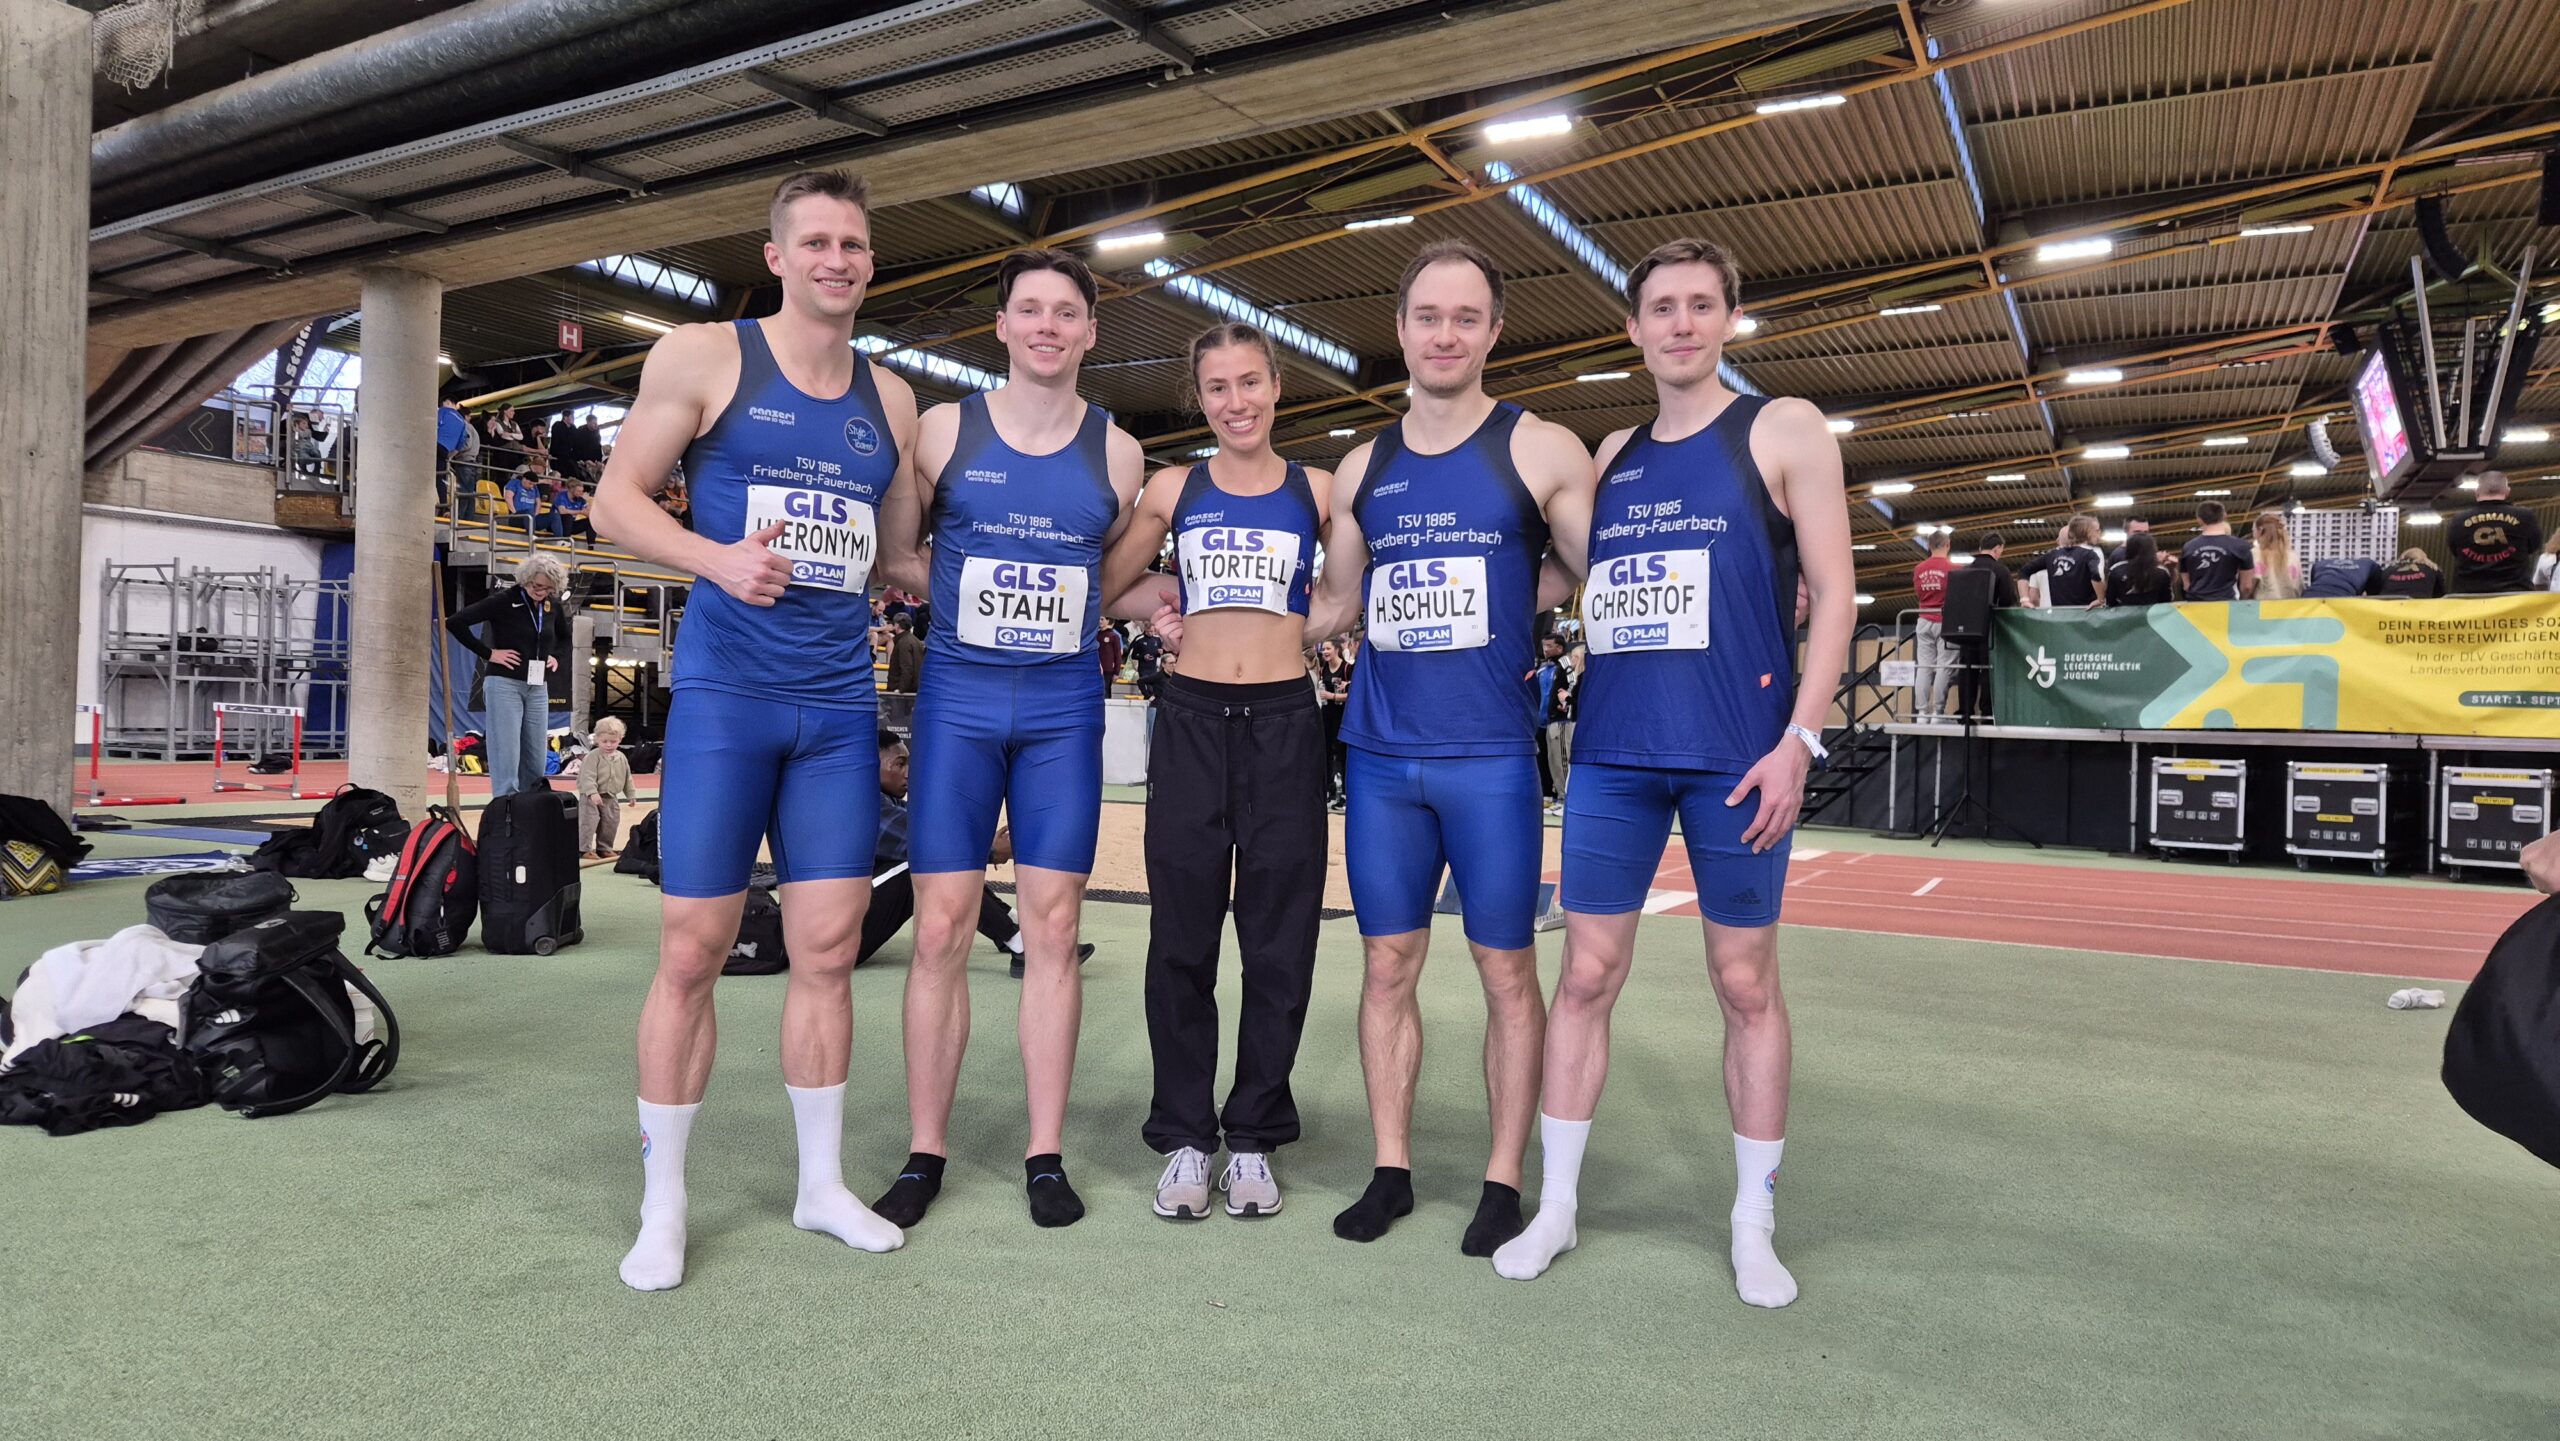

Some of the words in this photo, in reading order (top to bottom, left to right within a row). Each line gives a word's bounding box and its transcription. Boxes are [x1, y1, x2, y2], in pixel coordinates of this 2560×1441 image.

[563, 325, 577, 347] H
[286, 322, 313, 378] Stölti
[749, 405, 795, 421] panzeri
[796, 456, 816, 472] TSV
[818, 460, 842, 476] 1885
[752, 464, 874, 496] Friedberg-Fauerbach
[965, 469, 1007, 480] panzeri
[1373, 478, 1409, 496] panzeri
[1185, 509, 1225, 525] panzeri
[1627, 503, 1652, 520] TSV
[1654, 499, 1683, 518] 1885
[1008, 512, 1027, 526] TSV
[1029, 515, 1053, 529] 1885
[1397, 513, 1422, 529] TSV
[1424, 512, 1457, 528] 1885
[1596, 514, 1728, 541] riedberg-Fauerbach
[2464, 512, 2521, 528] GERMANY
[972, 521, 1085, 544] Friedberg-Fauerbach
[814, 565, 844, 580] PLAN
[1229, 588, 1262, 599] PLAN
[978, 589, 1070, 623] STAHL
[1376, 588, 1476, 624] H.SCHULZ
[1591, 585, 1696, 622] CHRISTOF
[2378, 619, 2413, 631] DEIN
[2418, 617, 2530, 631] FREIWILLIGES
[2535, 616, 2560, 629] SO
[1019, 631, 1051, 643] PLAN
[1418, 629, 1451, 640] PLAN
[1633, 627, 1667, 639] PLAN
[2064, 653, 2114, 662] DEUTSCHE
[2416, 652, 2428, 662] In
[2433, 651, 2456, 663] der
[2460, 651, 2487, 662] DLV
[2063, 662, 2142, 672] LEICHTATHLETIK
[2409, 663, 2532, 675] Landesverbänden
[2063, 671, 2100, 680] JUGEND
[2471, 694, 2513, 705] START:
[2515, 694, 2527, 705] 1.
